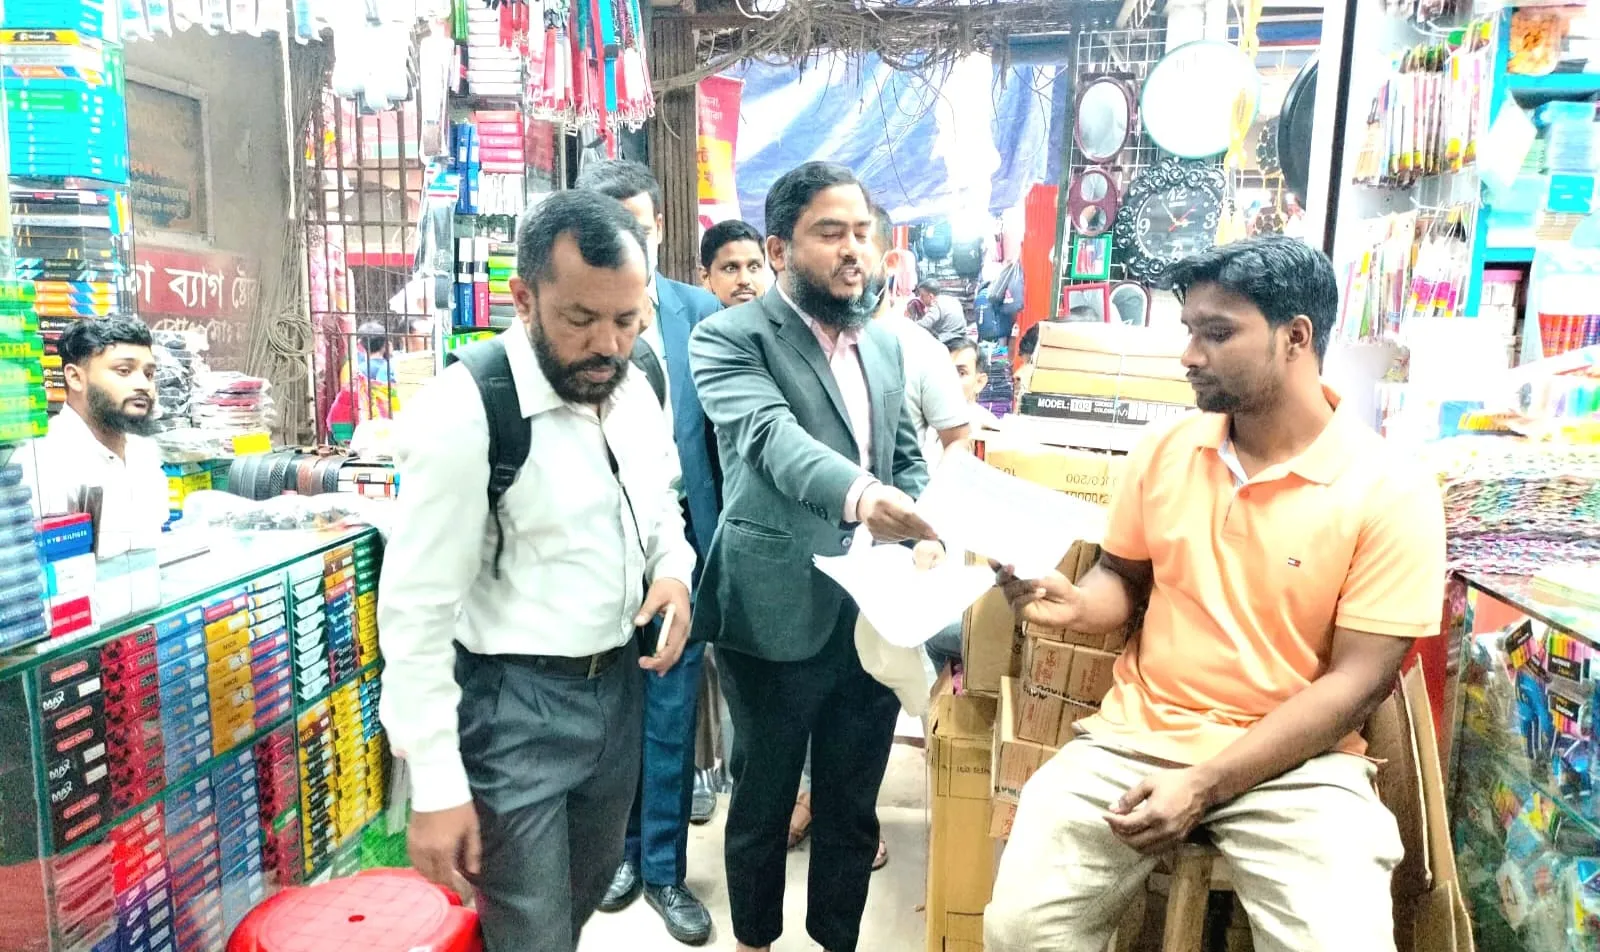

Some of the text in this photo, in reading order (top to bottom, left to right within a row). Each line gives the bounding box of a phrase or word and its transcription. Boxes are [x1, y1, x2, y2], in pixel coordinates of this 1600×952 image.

[1166, 186, 1188, 201] 12
[1139, 218, 1151, 237] 9
[1202, 211, 1216, 230] 3
[163, 264, 225, 309] ব্যাগ
[1037, 398, 1071, 409] MODEL:
[42, 690, 65, 710] MAX
[49, 758, 71, 781] MAX
[51, 780, 73, 803] MAX
